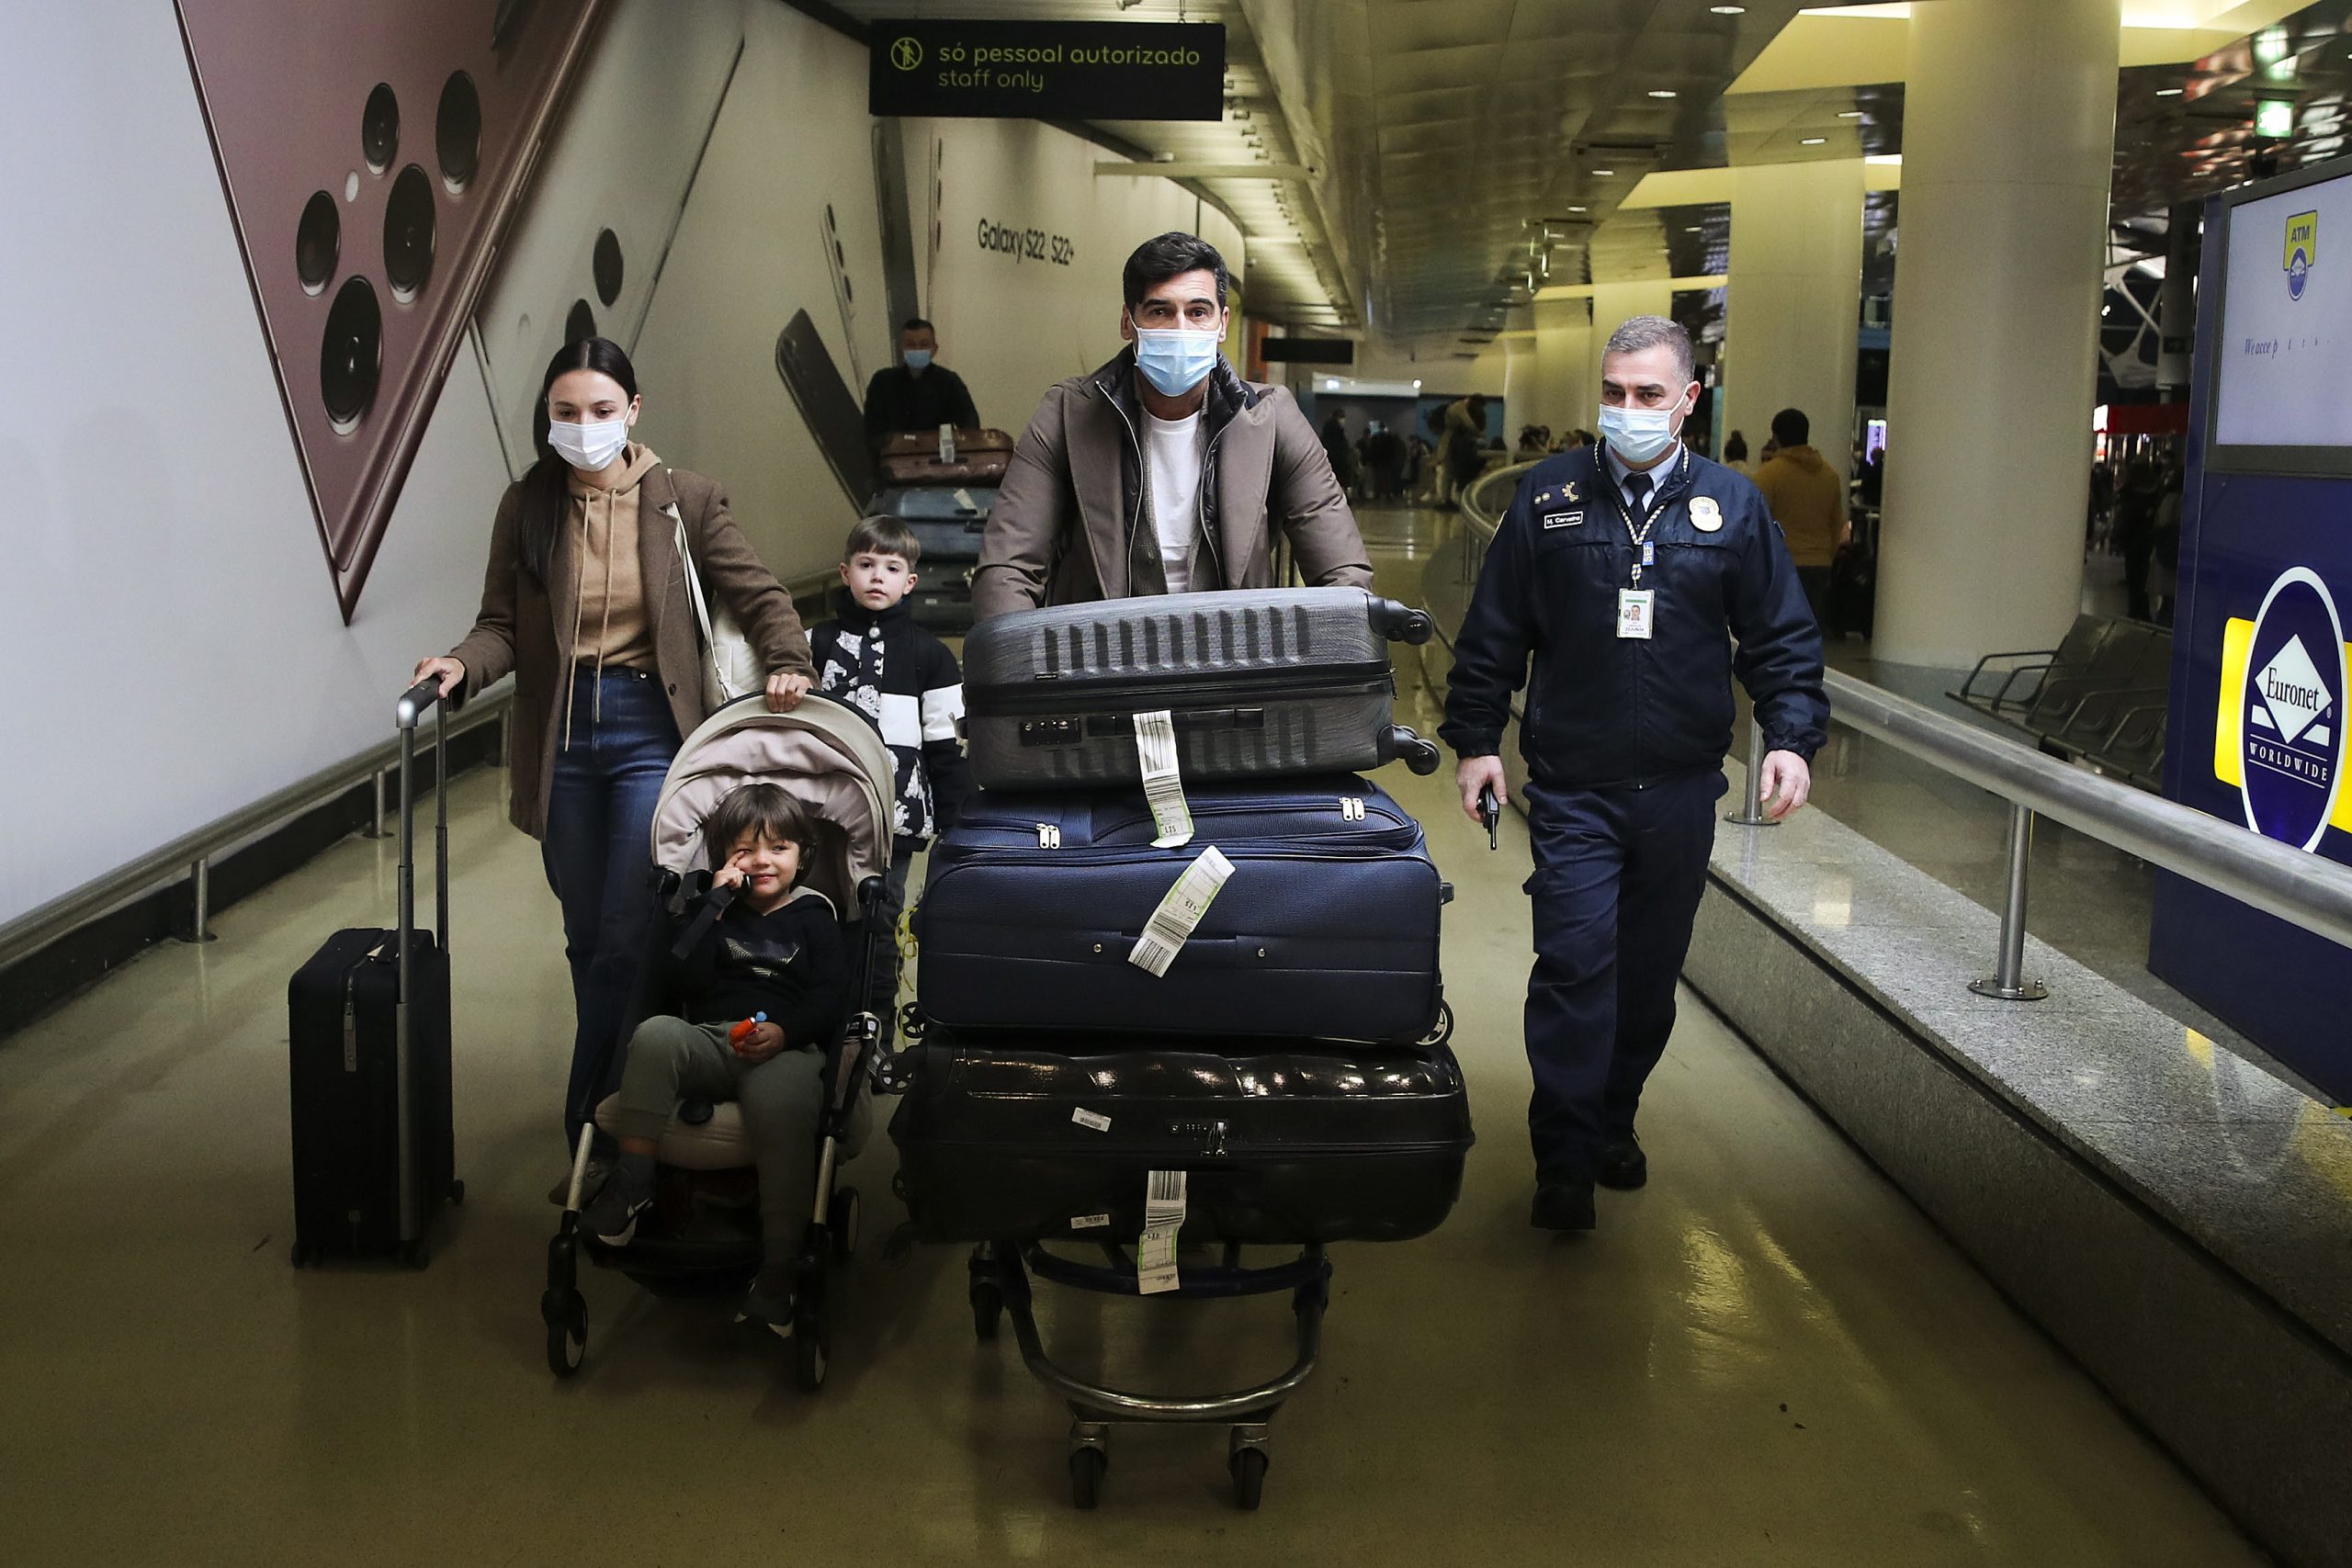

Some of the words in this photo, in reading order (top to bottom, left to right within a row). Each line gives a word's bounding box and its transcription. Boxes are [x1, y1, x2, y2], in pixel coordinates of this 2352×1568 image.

[939, 42, 966, 62] só
[974, 44, 1062, 67] pessoal
[1069, 45, 1200, 65] autorizado
[939, 70, 989, 86] staff
[997, 70, 1044, 93] only
[978, 218, 1024, 265] Galaxy
[1025, 228, 1046, 261] S22
[1051, 234, 1074, 265] S22+
[2290, 225, 2311, 243] ATM
[1643, 544, 1653, 562] SEF
[2266, 667, 2320, 712] Euronet
[2249, 741, 2328, 782] WORLDWIDE
